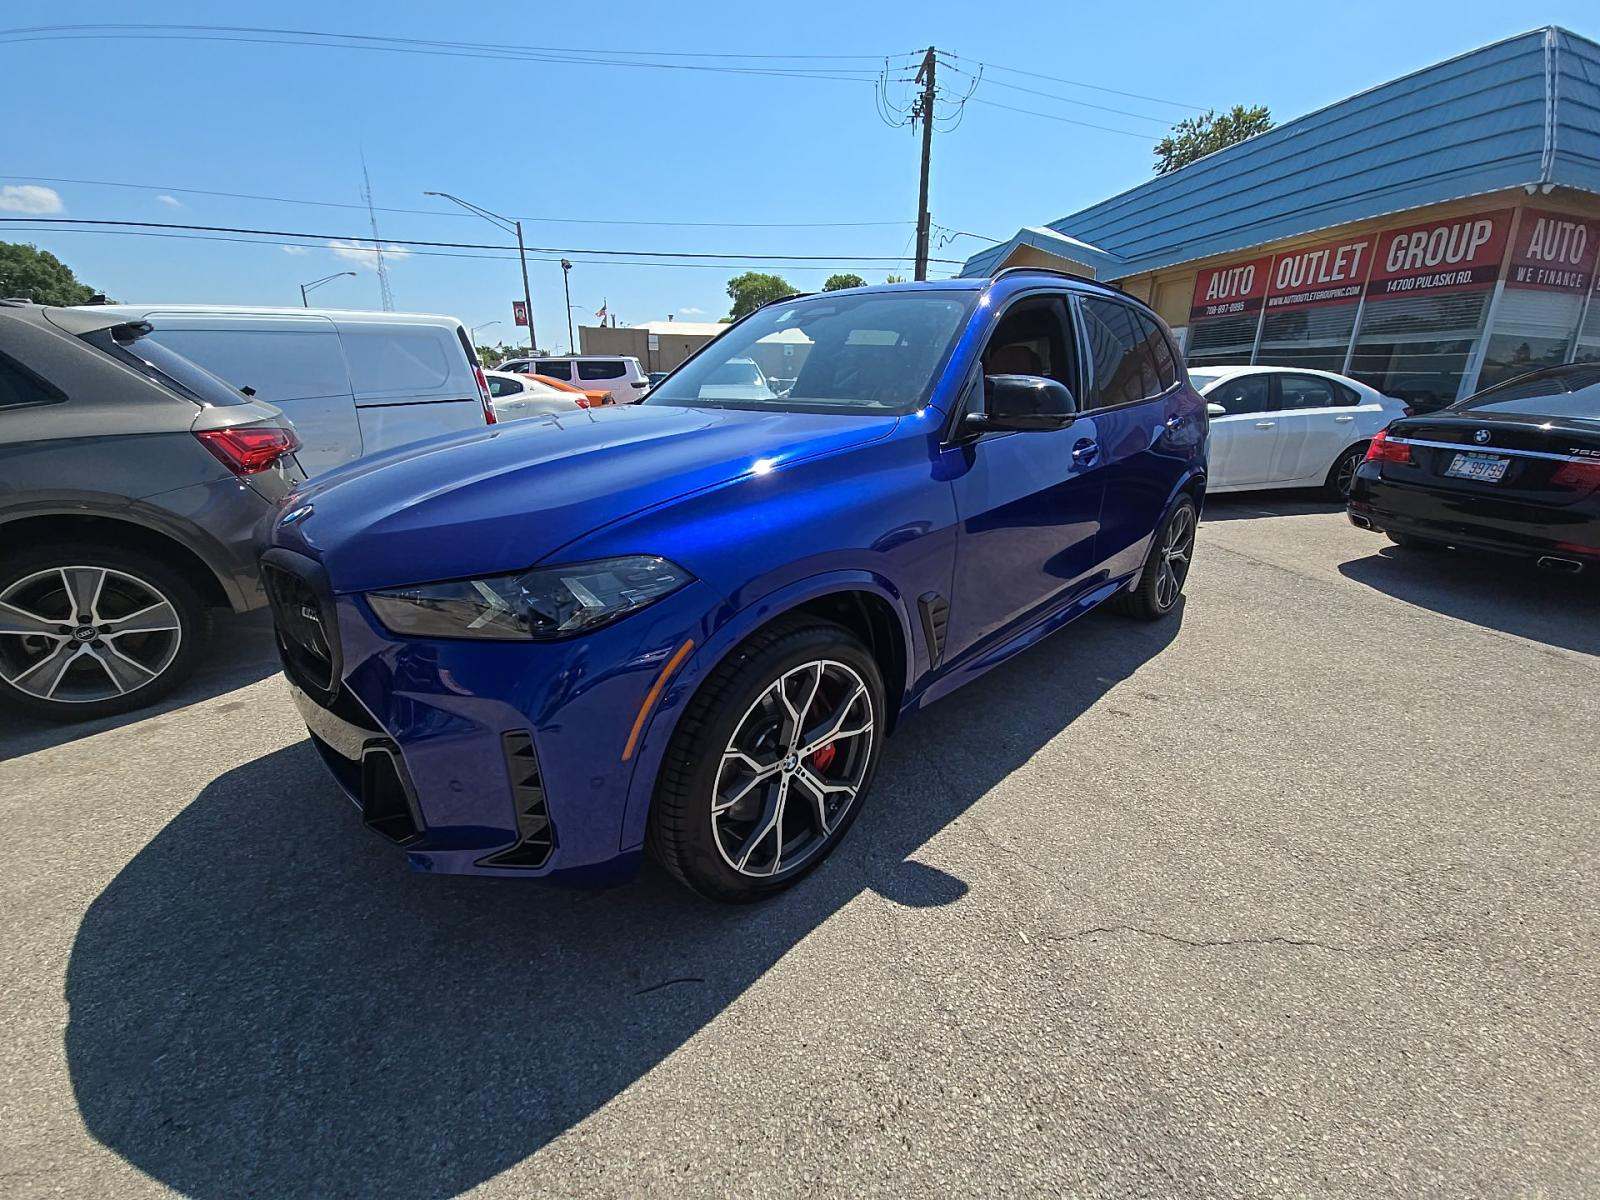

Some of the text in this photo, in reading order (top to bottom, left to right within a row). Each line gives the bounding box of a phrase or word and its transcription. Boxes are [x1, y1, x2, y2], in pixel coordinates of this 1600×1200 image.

[1526, 217, 1587, 265] AUTO
[1205, 219, 1493, 301] AUTO OUTLET GROUP
[1517, 266, 1534, 282] WE
[1537, 269, 1583, 288] FINANCE
[1386, 270, 1473, 293] 14700 PULASKI RD.
